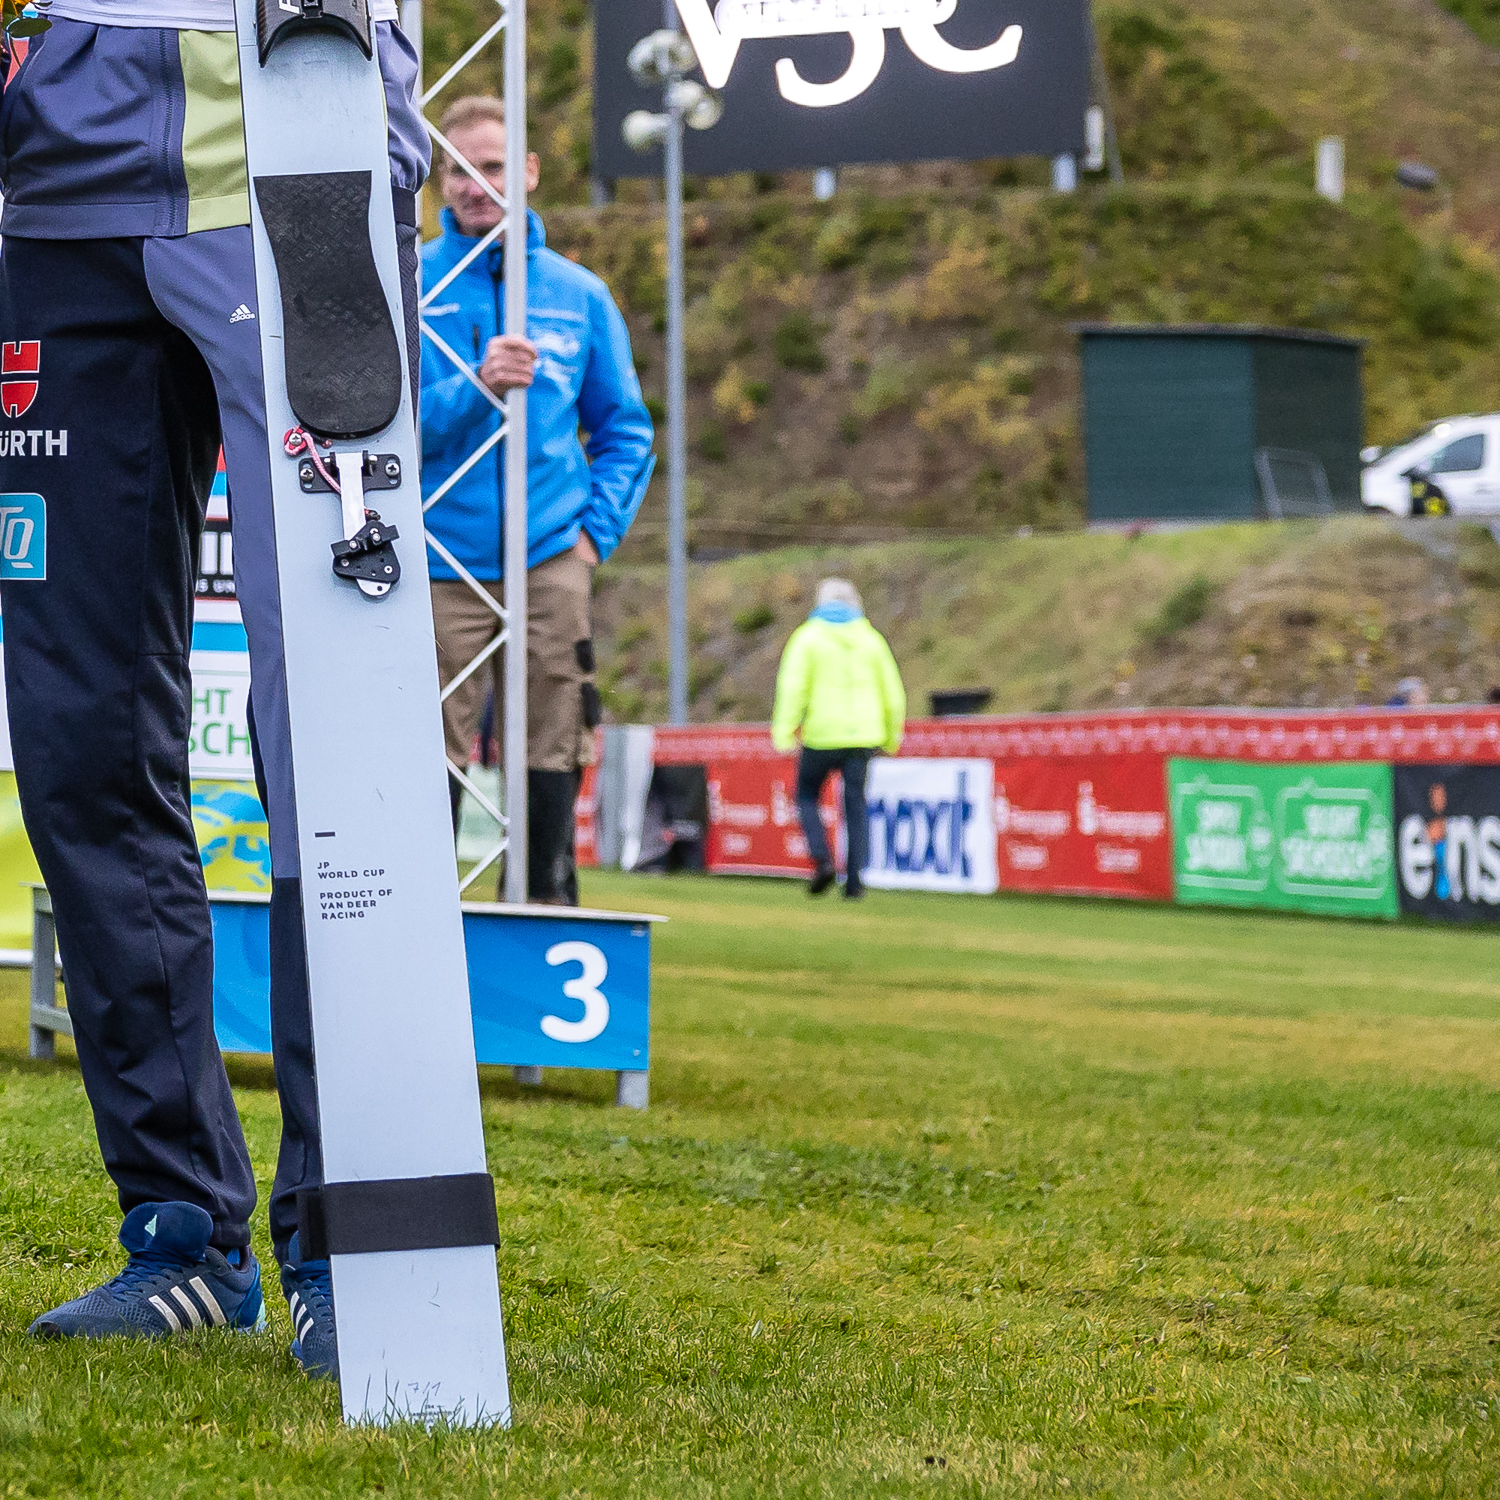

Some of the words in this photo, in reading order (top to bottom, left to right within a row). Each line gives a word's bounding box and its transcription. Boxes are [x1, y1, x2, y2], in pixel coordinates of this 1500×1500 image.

[317, 861, 331, 870] JP
[317, 870, 360, 880] WORLD
[362, 867, 386, 878] CUP
[319, 889, 374, 900] PRODUCT
[377, 888, 394, 898] OF
[320, 901, 344, 910] VAN
[346, 899, 378, 909] DEER
[321, 911, 366, 921] RACING
[540, 940, 610, 1044] 3
